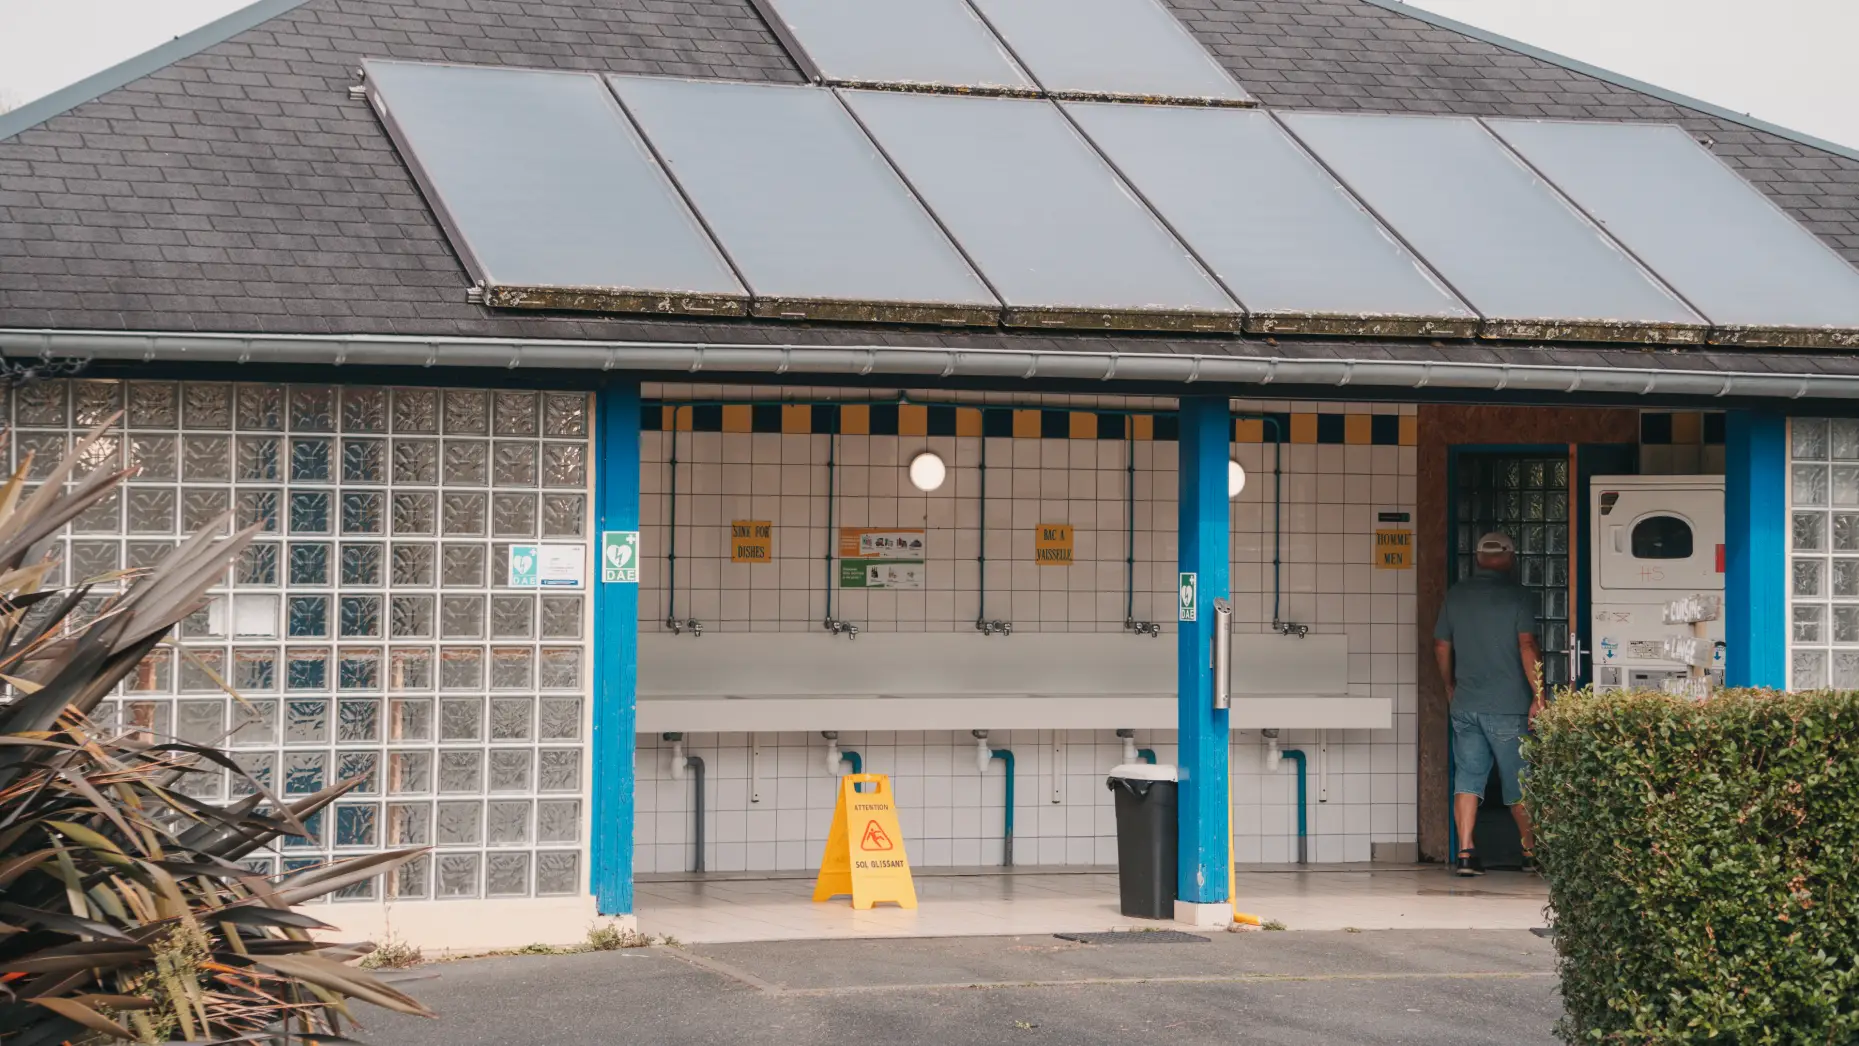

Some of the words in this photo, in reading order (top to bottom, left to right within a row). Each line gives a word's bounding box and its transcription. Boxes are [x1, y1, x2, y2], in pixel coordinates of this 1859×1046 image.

[733, 525, 751, 538] SINK
[755, 525, 770, 538] FOR
[1043, 528, 1057, 541] BAC
[738, 545, 765, 559] DISHES
[1384, 552, 1403, 565] MEN
[513, 576, 537, 585] DAE
[606, 570, 635, 581] DAE
[1181, 609, 1195, 619] DAE
[854, 803, 889, 811] ATTENTION
[855, 860, 869, 869] SOL
[871, 860, 904, 868] GLISSANT
